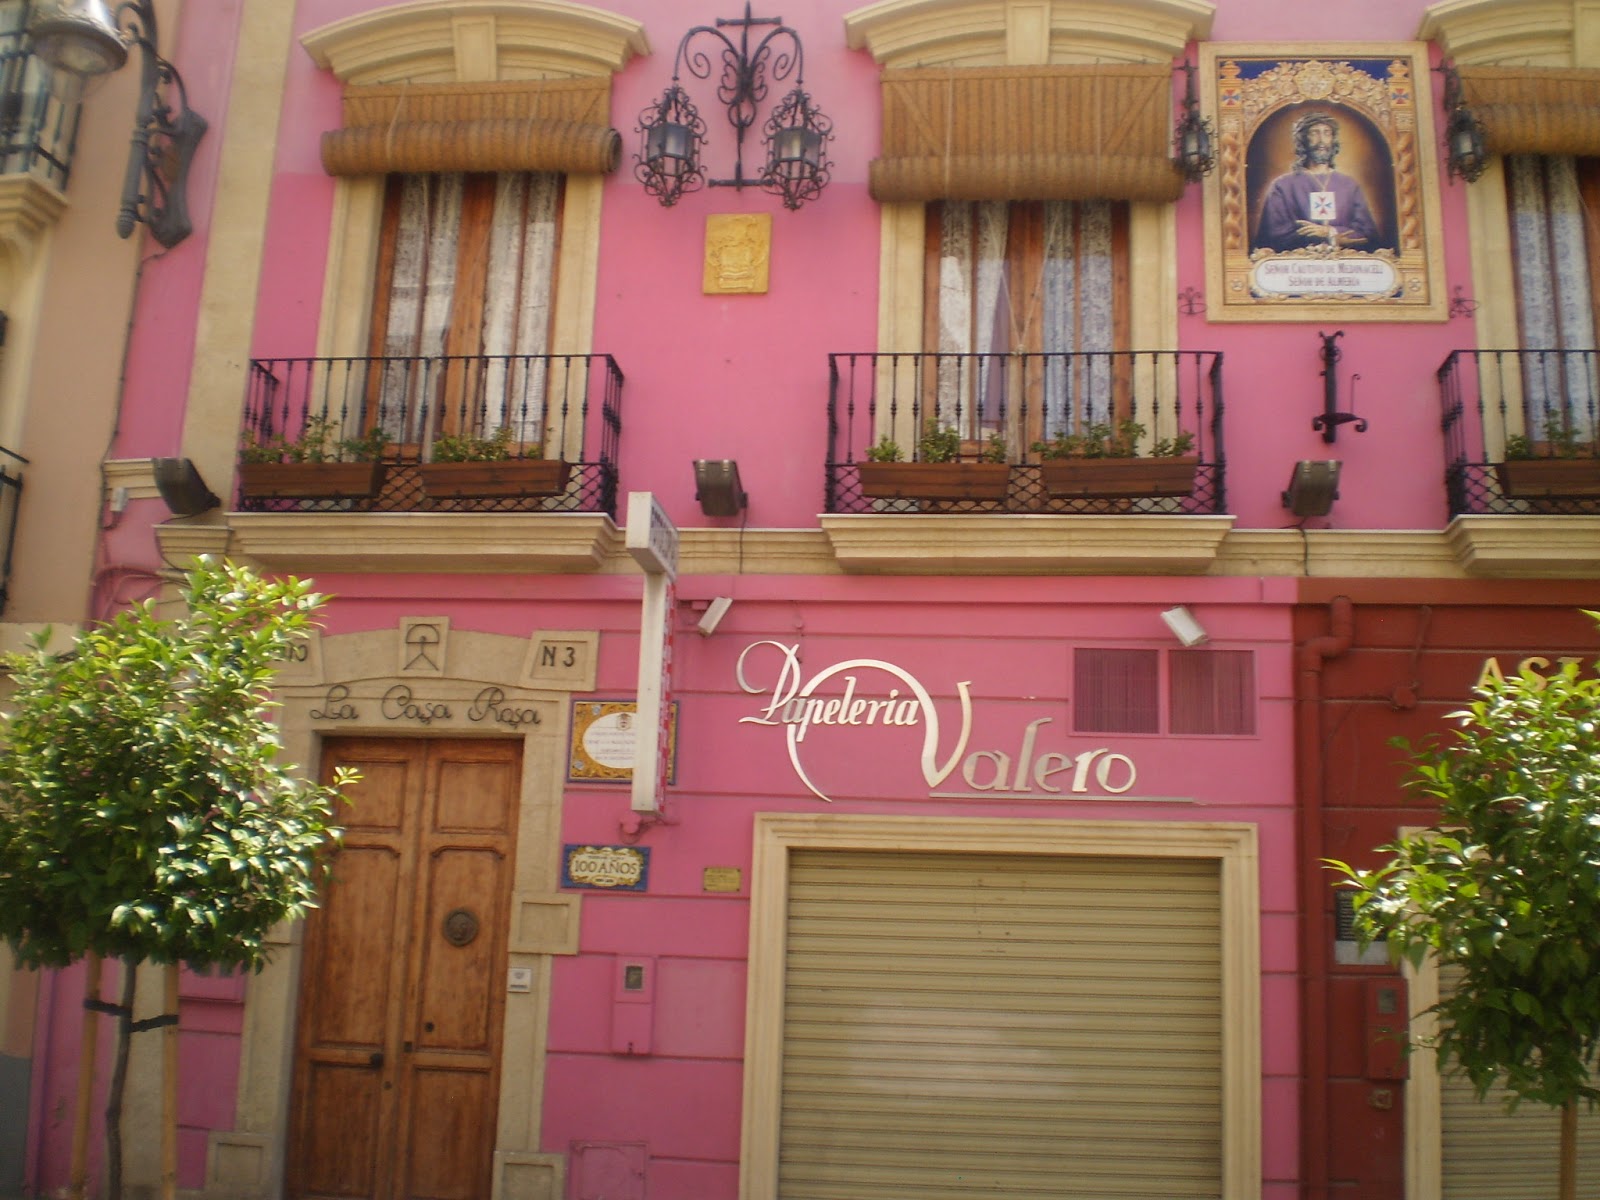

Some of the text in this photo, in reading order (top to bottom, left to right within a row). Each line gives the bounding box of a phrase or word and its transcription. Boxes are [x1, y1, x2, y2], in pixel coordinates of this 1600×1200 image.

[540, 646, 577, 668] N 3
[309, 684, 542, 729] La Casa Rosa
[736, 640, 919, 742] Papeleria
[890, 672, 1137, 796] Valero
[574, 859, 638, 876] 100 AÑOS
